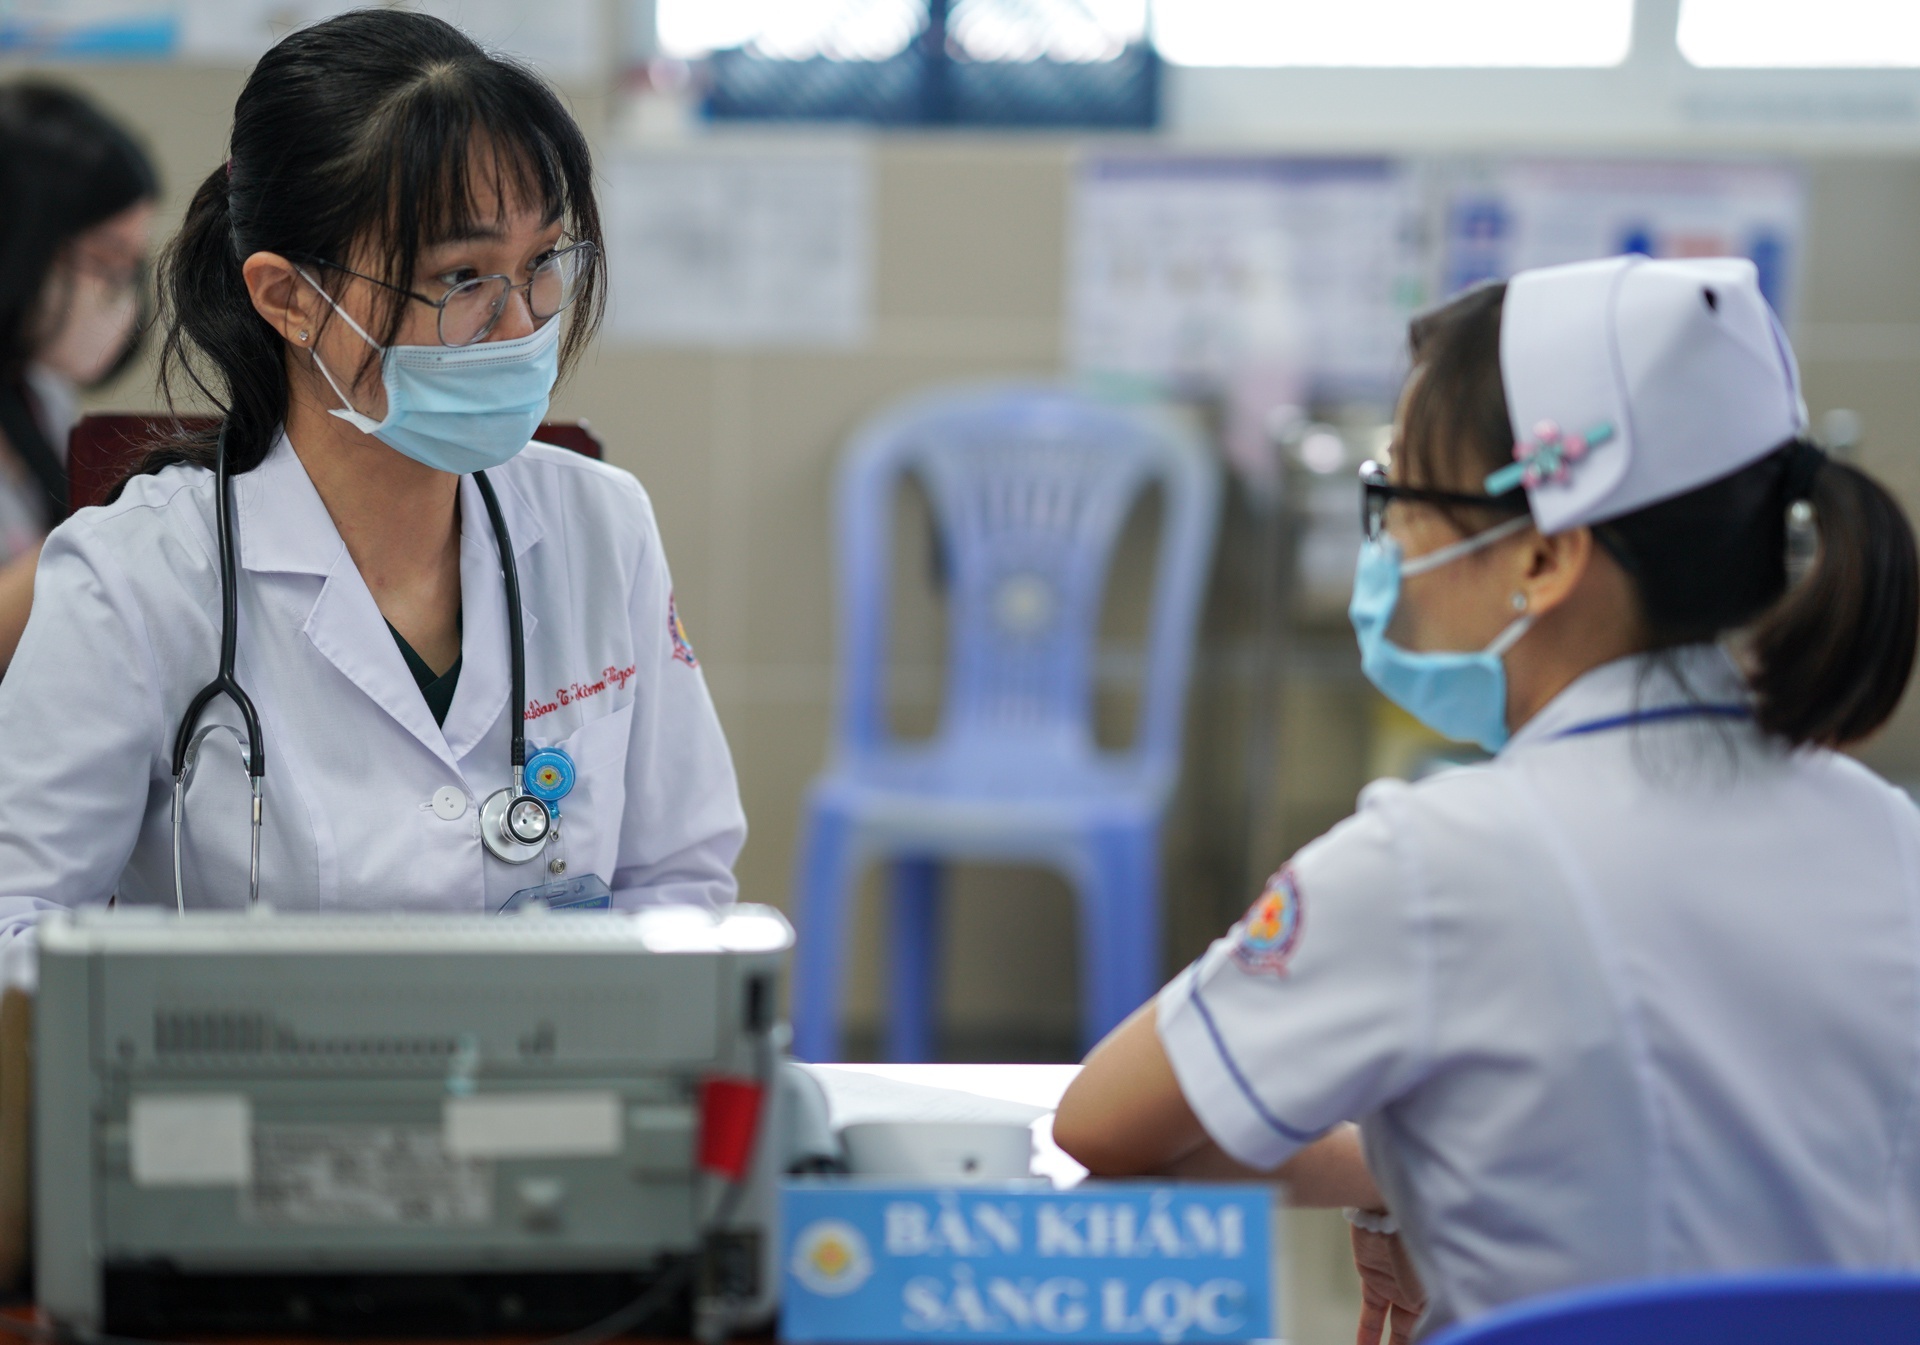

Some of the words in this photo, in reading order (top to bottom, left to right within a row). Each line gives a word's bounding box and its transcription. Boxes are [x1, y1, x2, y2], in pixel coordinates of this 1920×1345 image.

[884, 1189, 1021, 1257] BÀN
[1037, 1189, 1244, 1258] KHÁM
[902, 1262, 1087, 1333] SÀNG
[1101, 1276, 1247, 1343] LỌC
